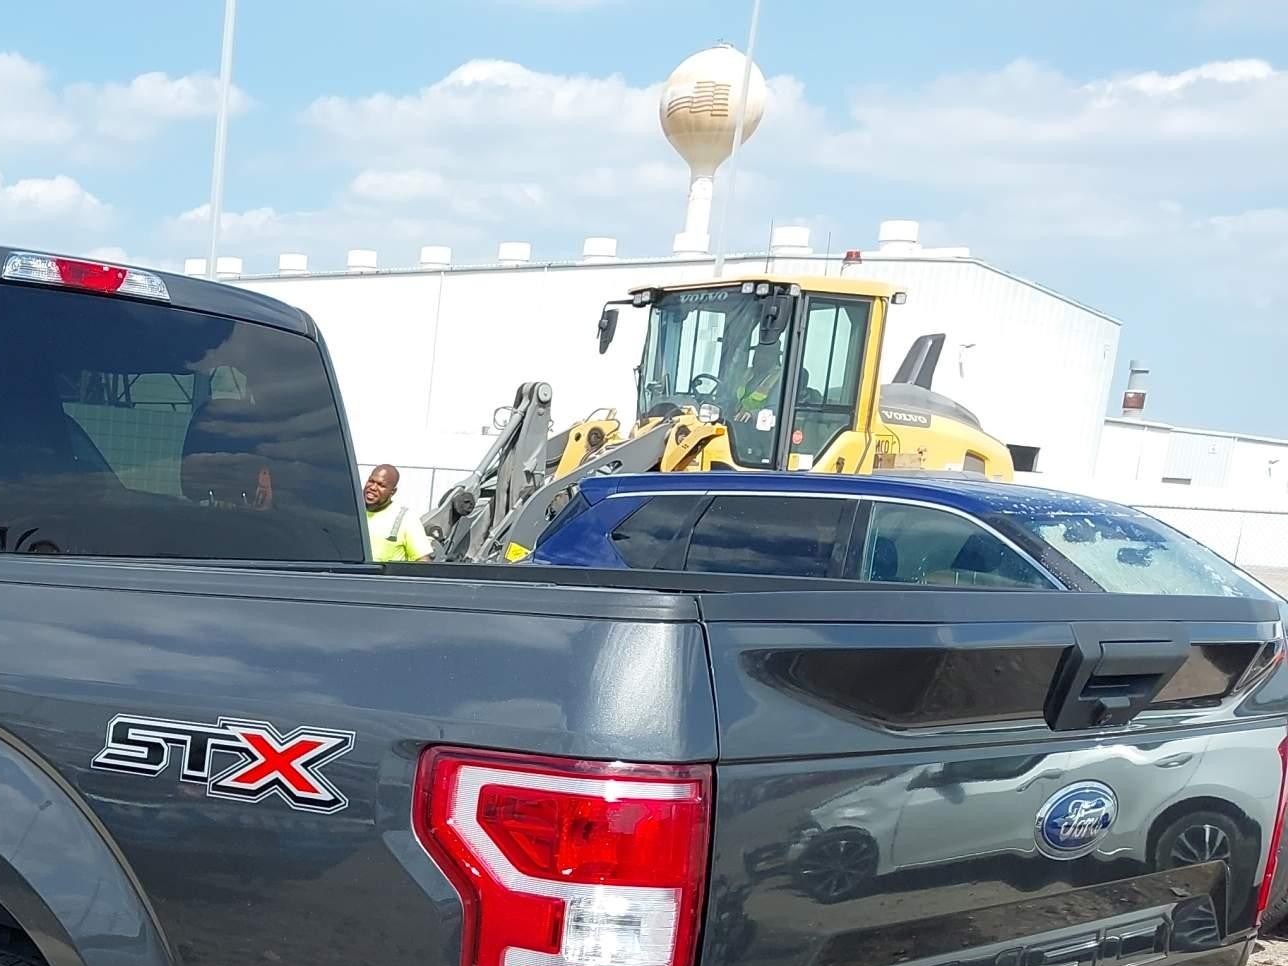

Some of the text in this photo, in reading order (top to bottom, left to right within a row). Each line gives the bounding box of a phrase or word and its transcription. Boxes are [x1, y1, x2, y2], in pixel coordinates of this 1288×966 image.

[881, 410, 928, 424] VOLVO
[91, 713, 356, 814] STX
[1053, 797, 1107, 841] Ford
